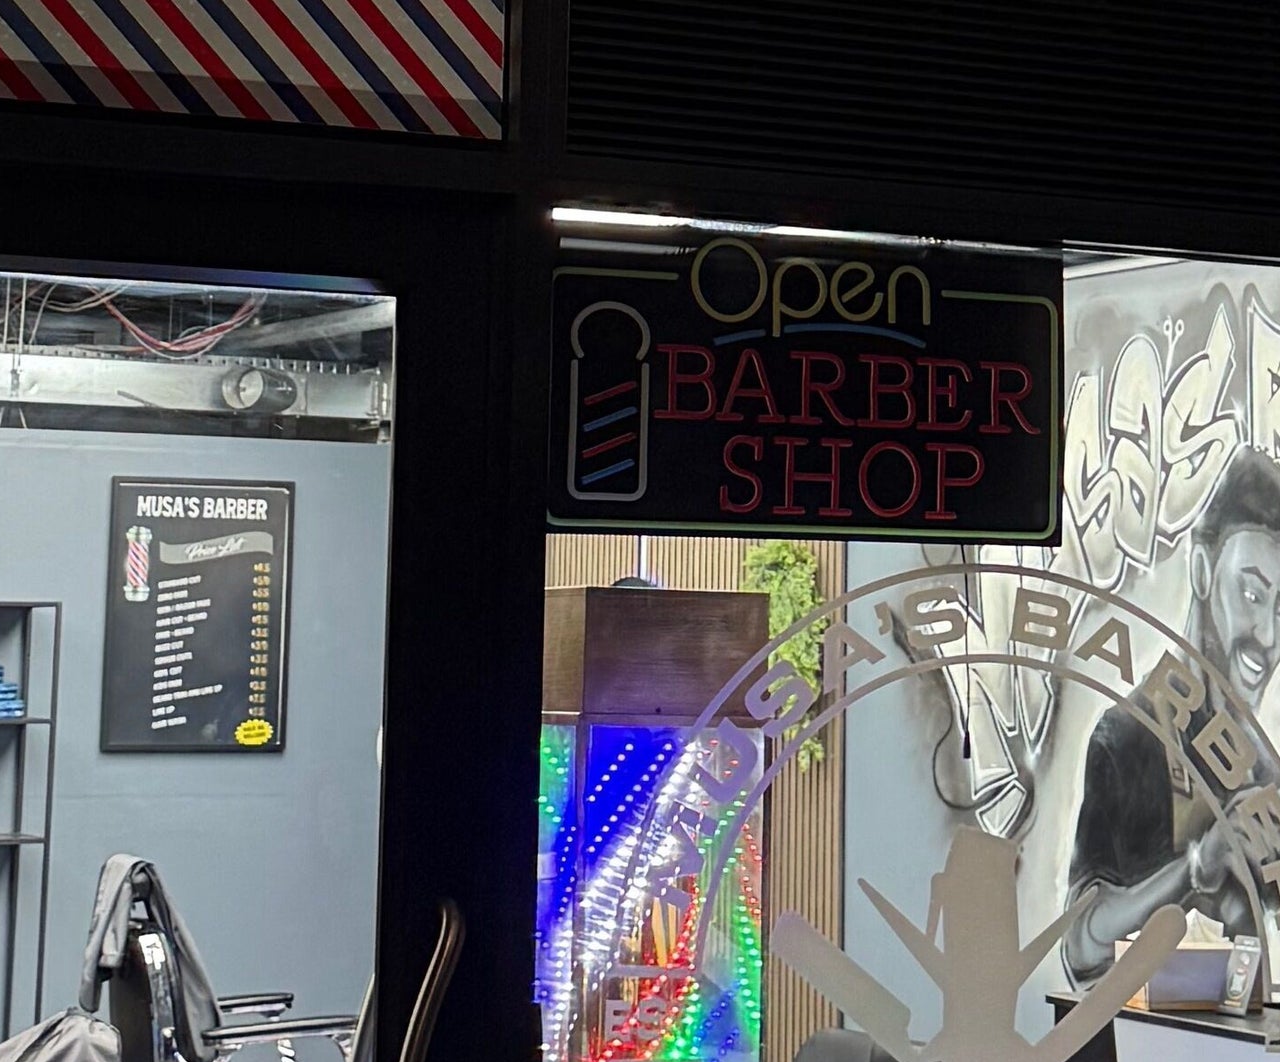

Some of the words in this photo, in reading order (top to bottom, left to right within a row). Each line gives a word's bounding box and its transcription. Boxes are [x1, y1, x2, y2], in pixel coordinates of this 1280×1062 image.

[691, 237, 931, 337] Open
[654, 343, 1041, 435] BARBER
[136, 495, 200, 518] MUSA'S
[202, 497, 268, 520] BARBER
[720, 434, 986, 521] SHOP
[648, 586, 967, 910] MUSA'S
